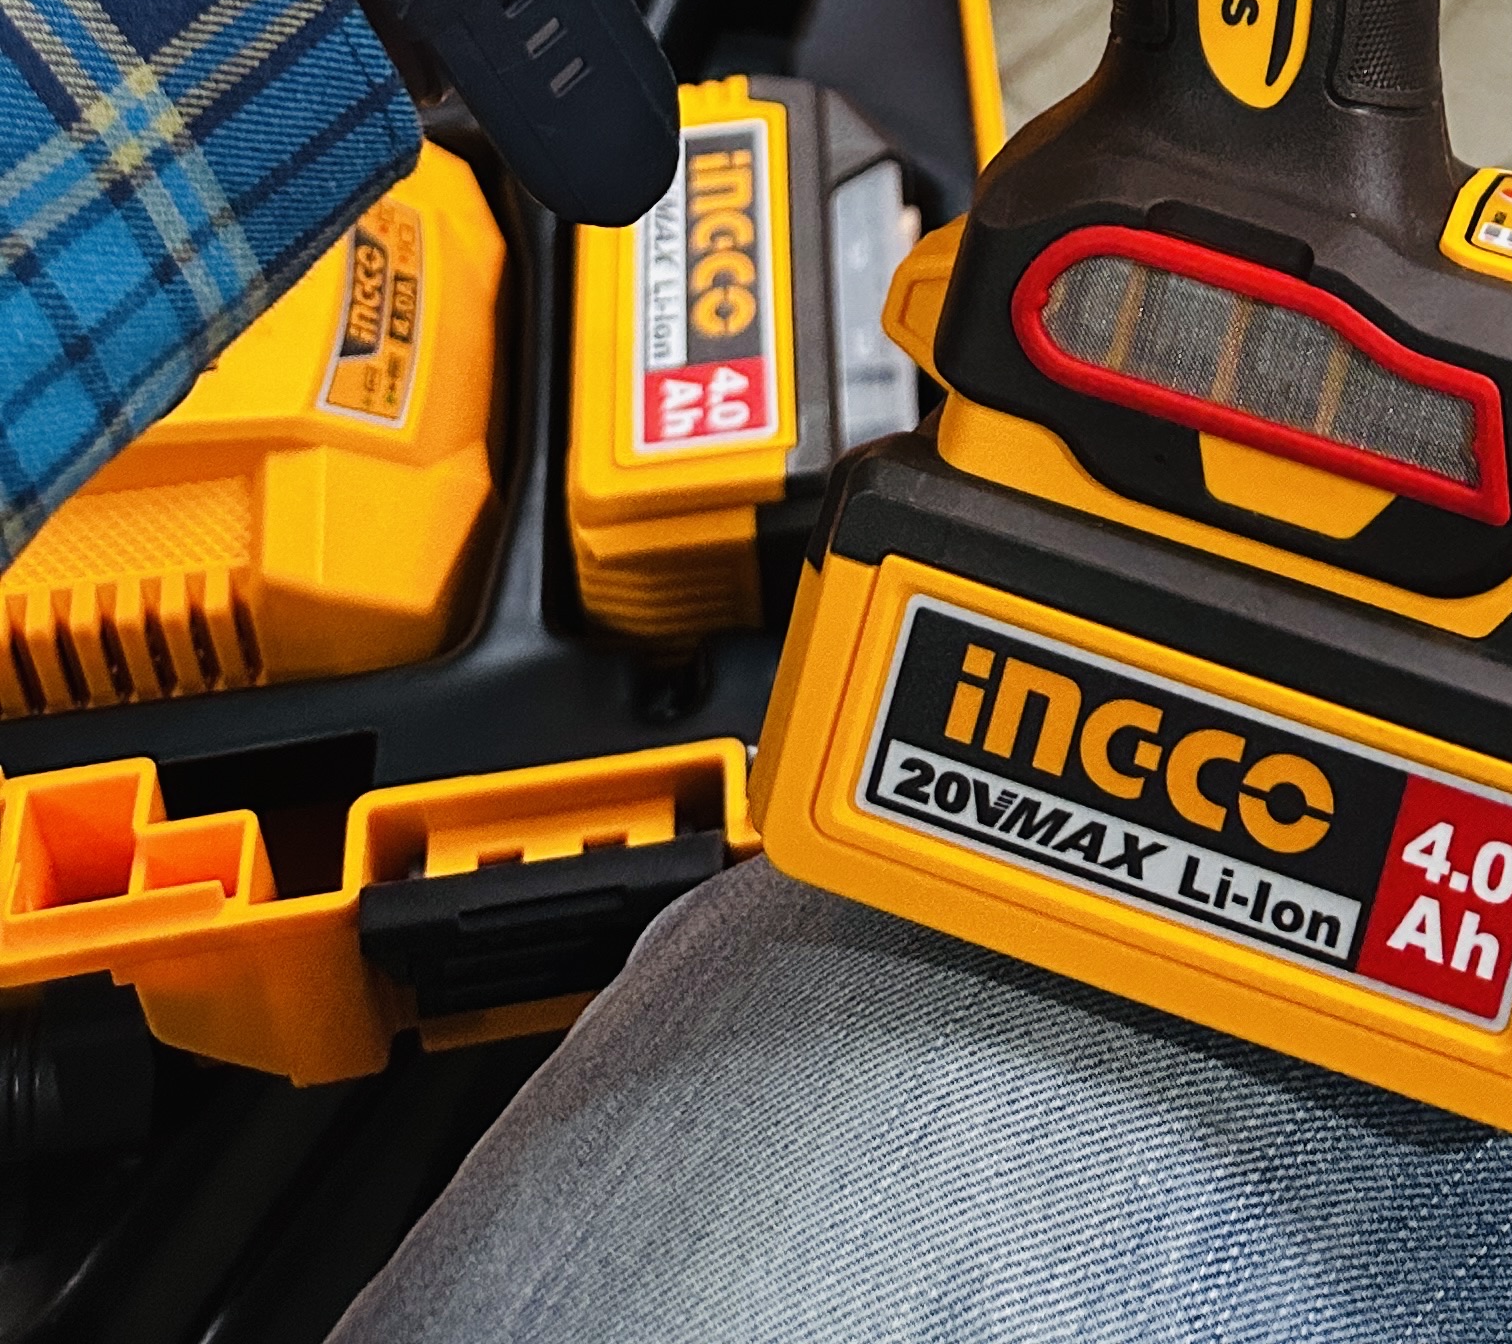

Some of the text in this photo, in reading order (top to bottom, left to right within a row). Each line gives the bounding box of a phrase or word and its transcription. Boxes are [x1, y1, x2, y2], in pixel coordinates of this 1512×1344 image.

[660, 378, 704, 438] Ah
[708, 366, 751, 430] 4.0
[1178, 855, 1344, 949] Li-Ion
[1387, 900, 1500, 980] Ah
